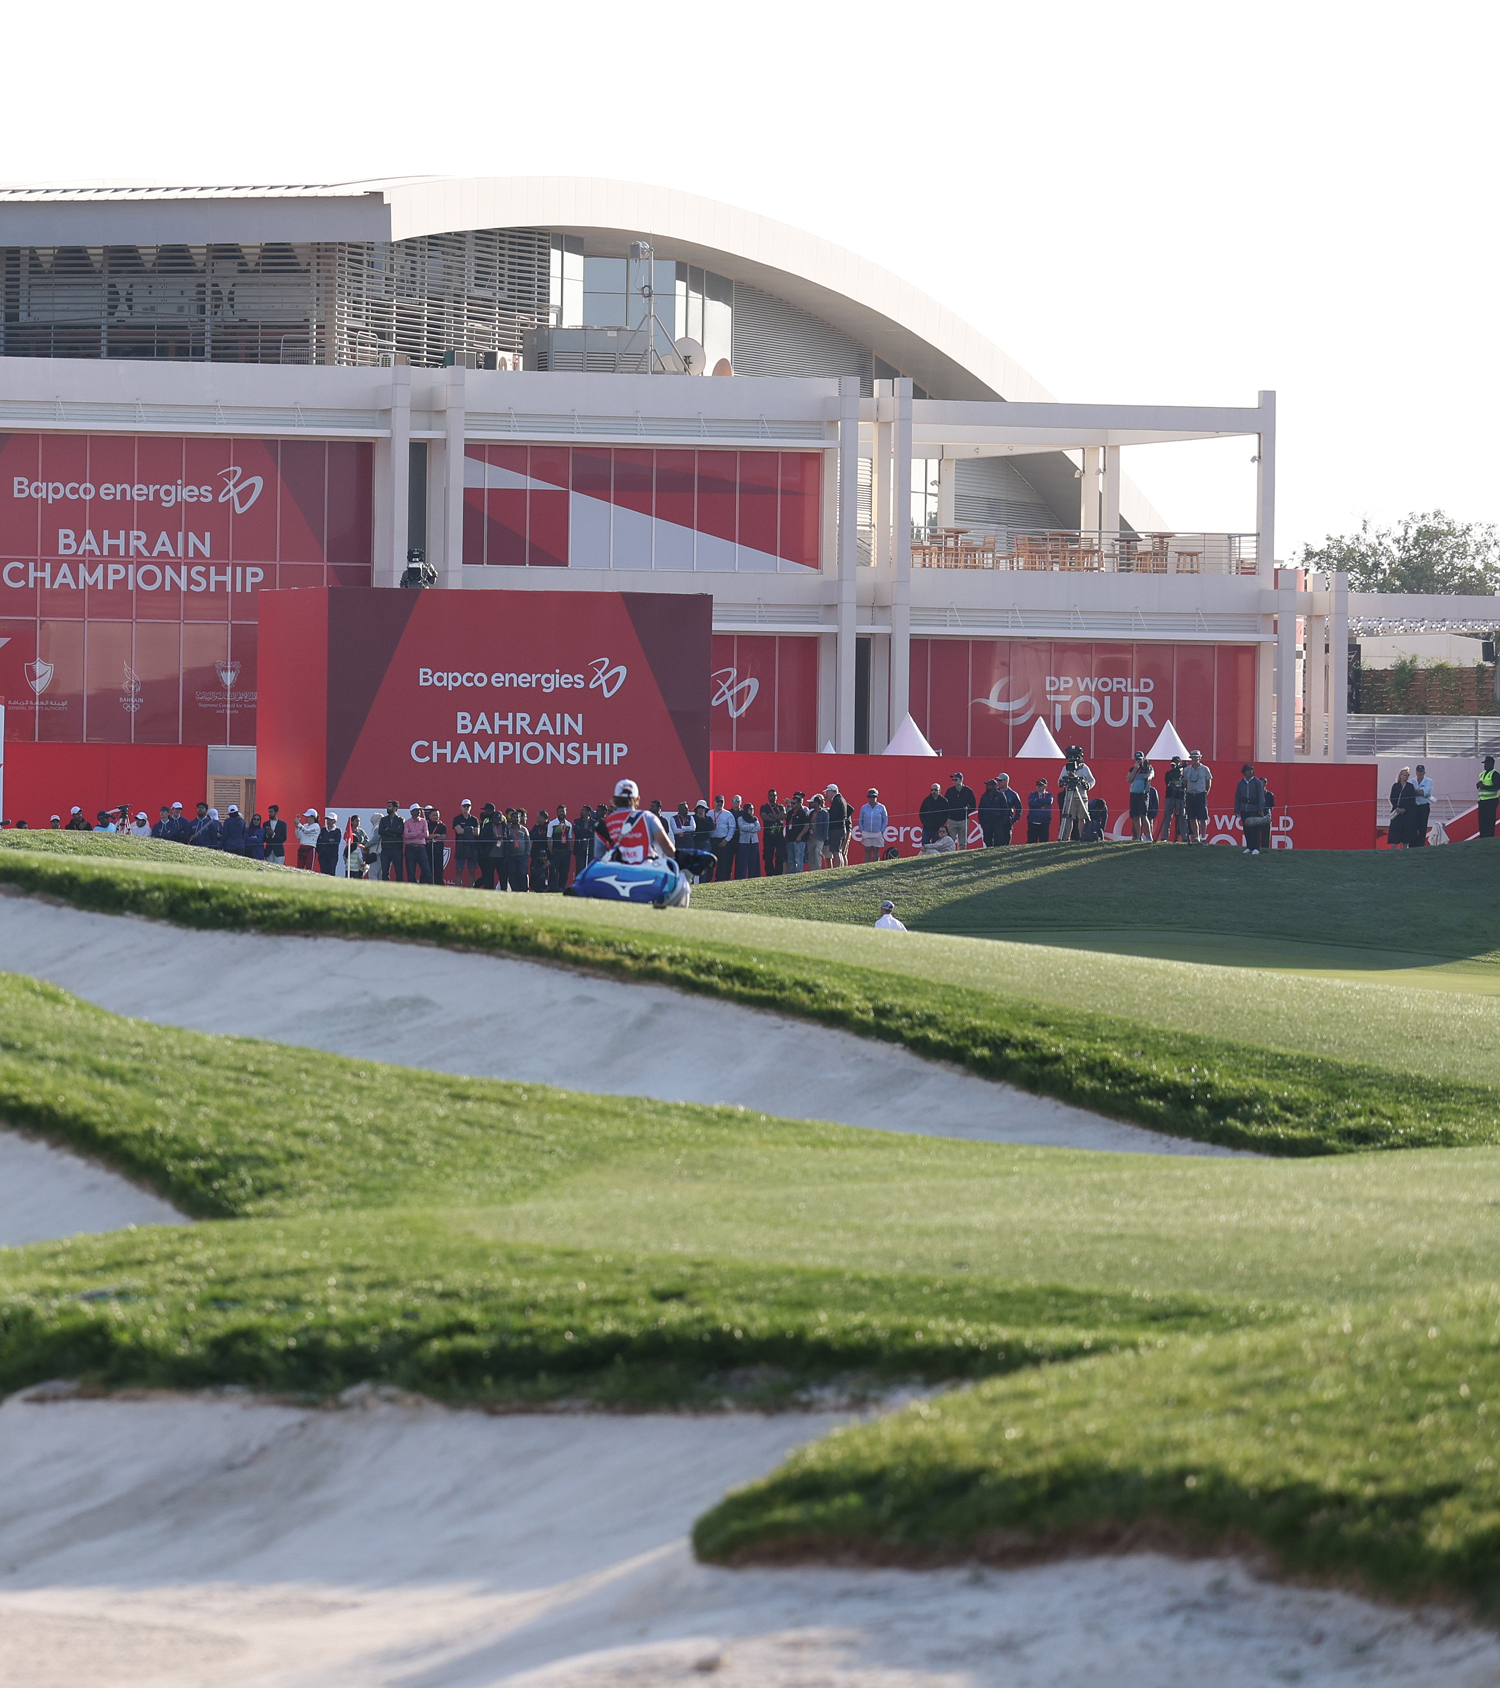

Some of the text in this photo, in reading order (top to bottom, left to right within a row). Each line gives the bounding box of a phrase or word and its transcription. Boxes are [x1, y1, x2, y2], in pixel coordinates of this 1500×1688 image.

[13, 476, 213, 508] Bapco energies
[58, 528, 211, 558] BAHRAIN
[2, 561, 264, 593] CHAMPIONSHIP
[419, 667, 585, 693] Bapco energies
[1045, 676, 1155, 693] DP WORLD
[456, 711, 583, 736] BAHRAIN
[1046, 694, 1157, 732] TOUR
[410, 740, 628, 765] CHAMPIONSHIP
